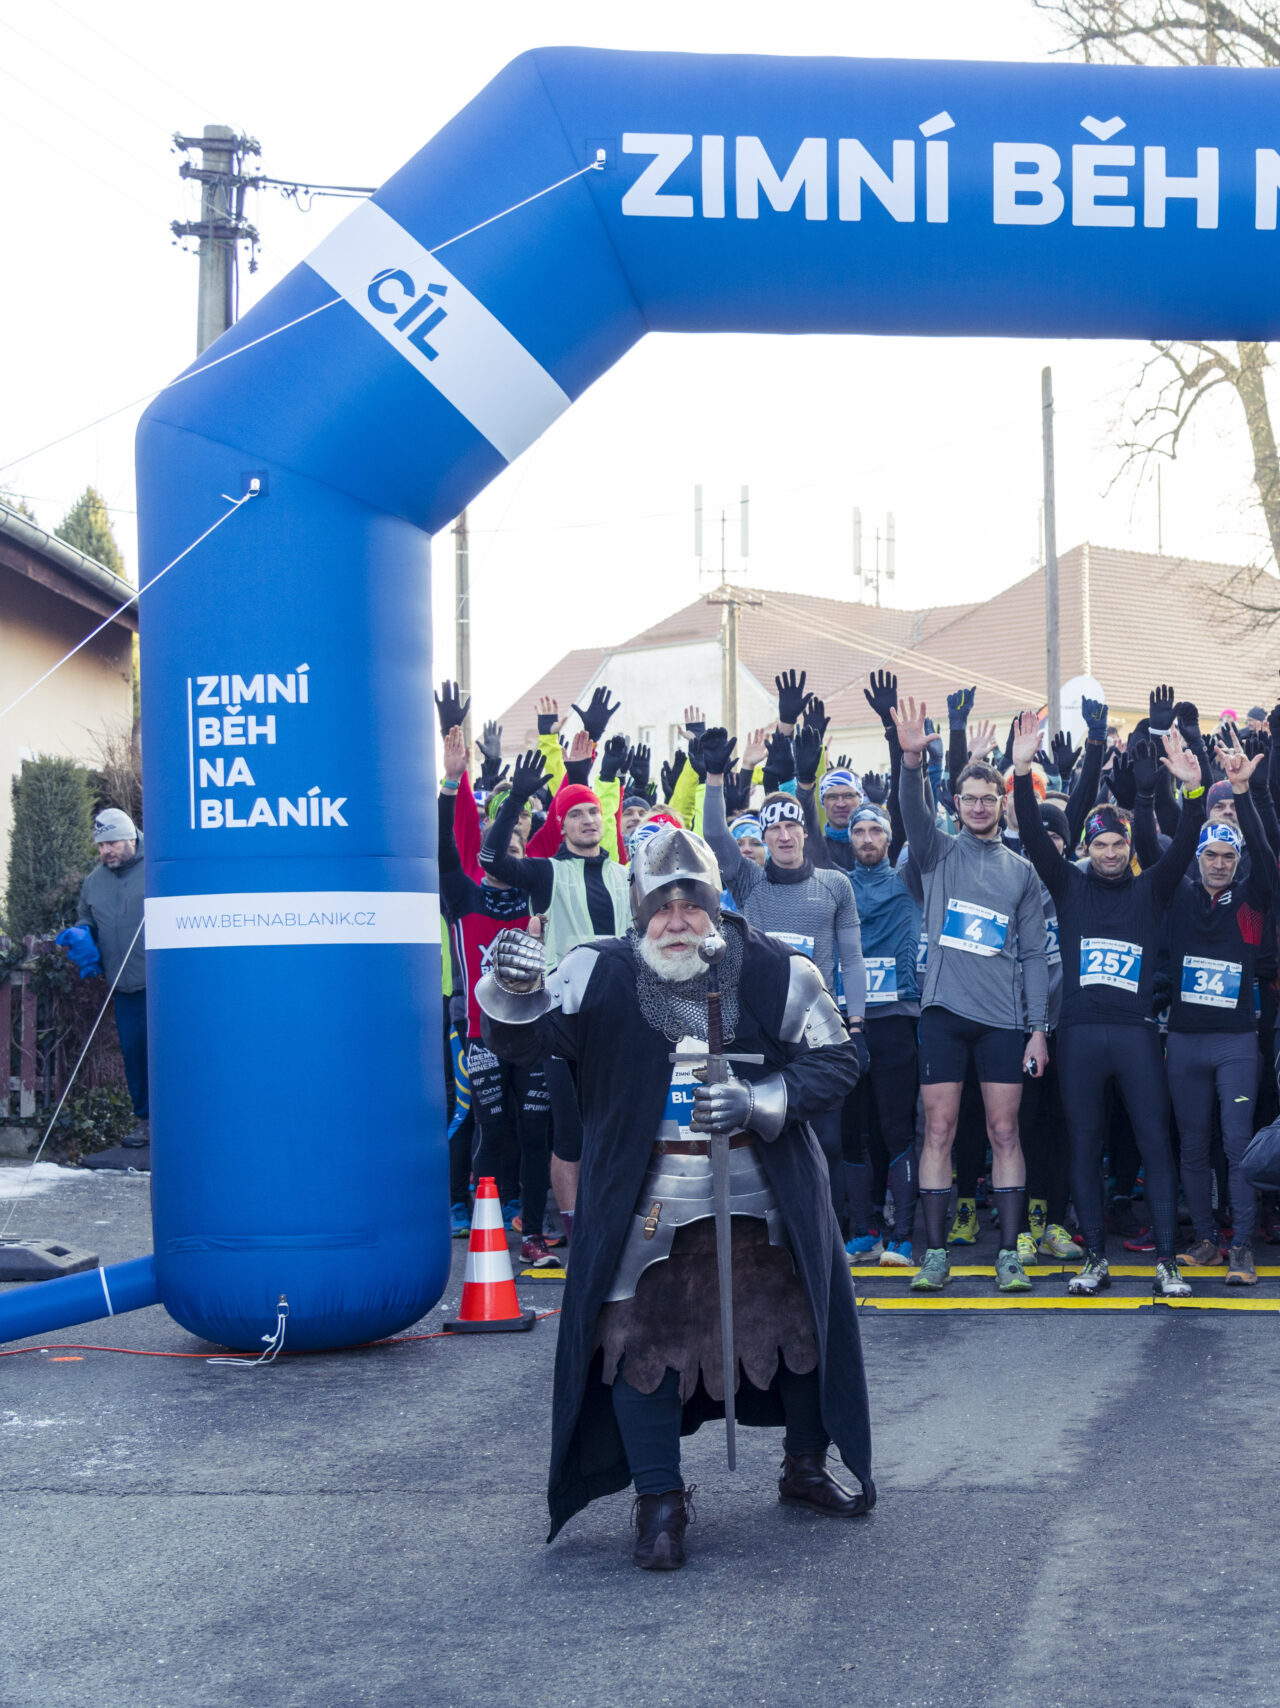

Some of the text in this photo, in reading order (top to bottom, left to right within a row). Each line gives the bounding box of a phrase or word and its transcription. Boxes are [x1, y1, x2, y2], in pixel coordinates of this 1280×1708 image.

[622, 111, 956, 223] ZIMNÍ
[993, 115, 1219, 229] BĚH
[367, 268, 448, 362] CÍL
[196, 662, 310, 706] ZIMNÍ
[198, 704, 277, 747] BĚH
[199, 757, 256, 788] NA
[200, 786, 349, 829] BLANÍK
[175, 911, 377, 930] WWW.BEHNABLANIK.CZ
[965, 918, 983, 941] 4
[1087, 950, 1135, 977] 257
[1193, 970, 1225, 995] 34
